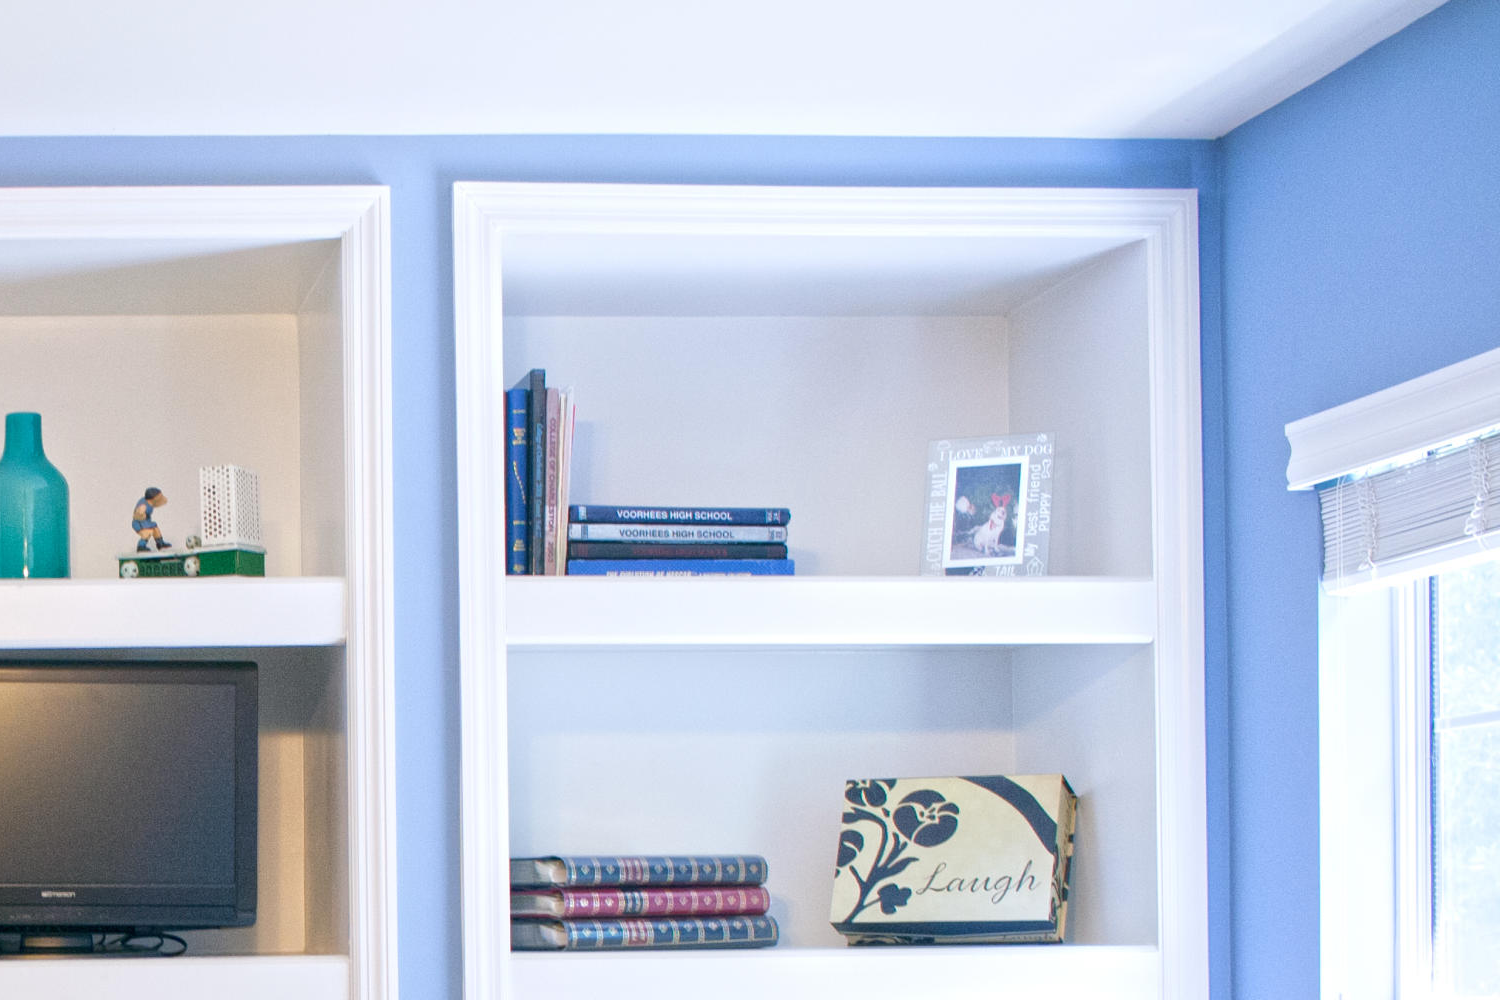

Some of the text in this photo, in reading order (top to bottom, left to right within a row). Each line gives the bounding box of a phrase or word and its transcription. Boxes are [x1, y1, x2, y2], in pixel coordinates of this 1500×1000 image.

[949, 448, 984, 461] LOVE
[1001, 446, 1020, 457] MY
[1024, 443, 1052, 456] DOG
[931, 472, 948, 498] BALL
[1028, 463, 1041, 503] friend
[617, 510, 733, 521] VOORHEES HIGH SCHOOL
[1027, 511, 1039, 536] best
[1038, 493, 1052, 532] PUPPY
[619, 529, 735, 539] VOORHEES HIGH SCHOOL
[926, 527, 944, 562] CATCH
[916, 859, 1042, 904] Laugh
